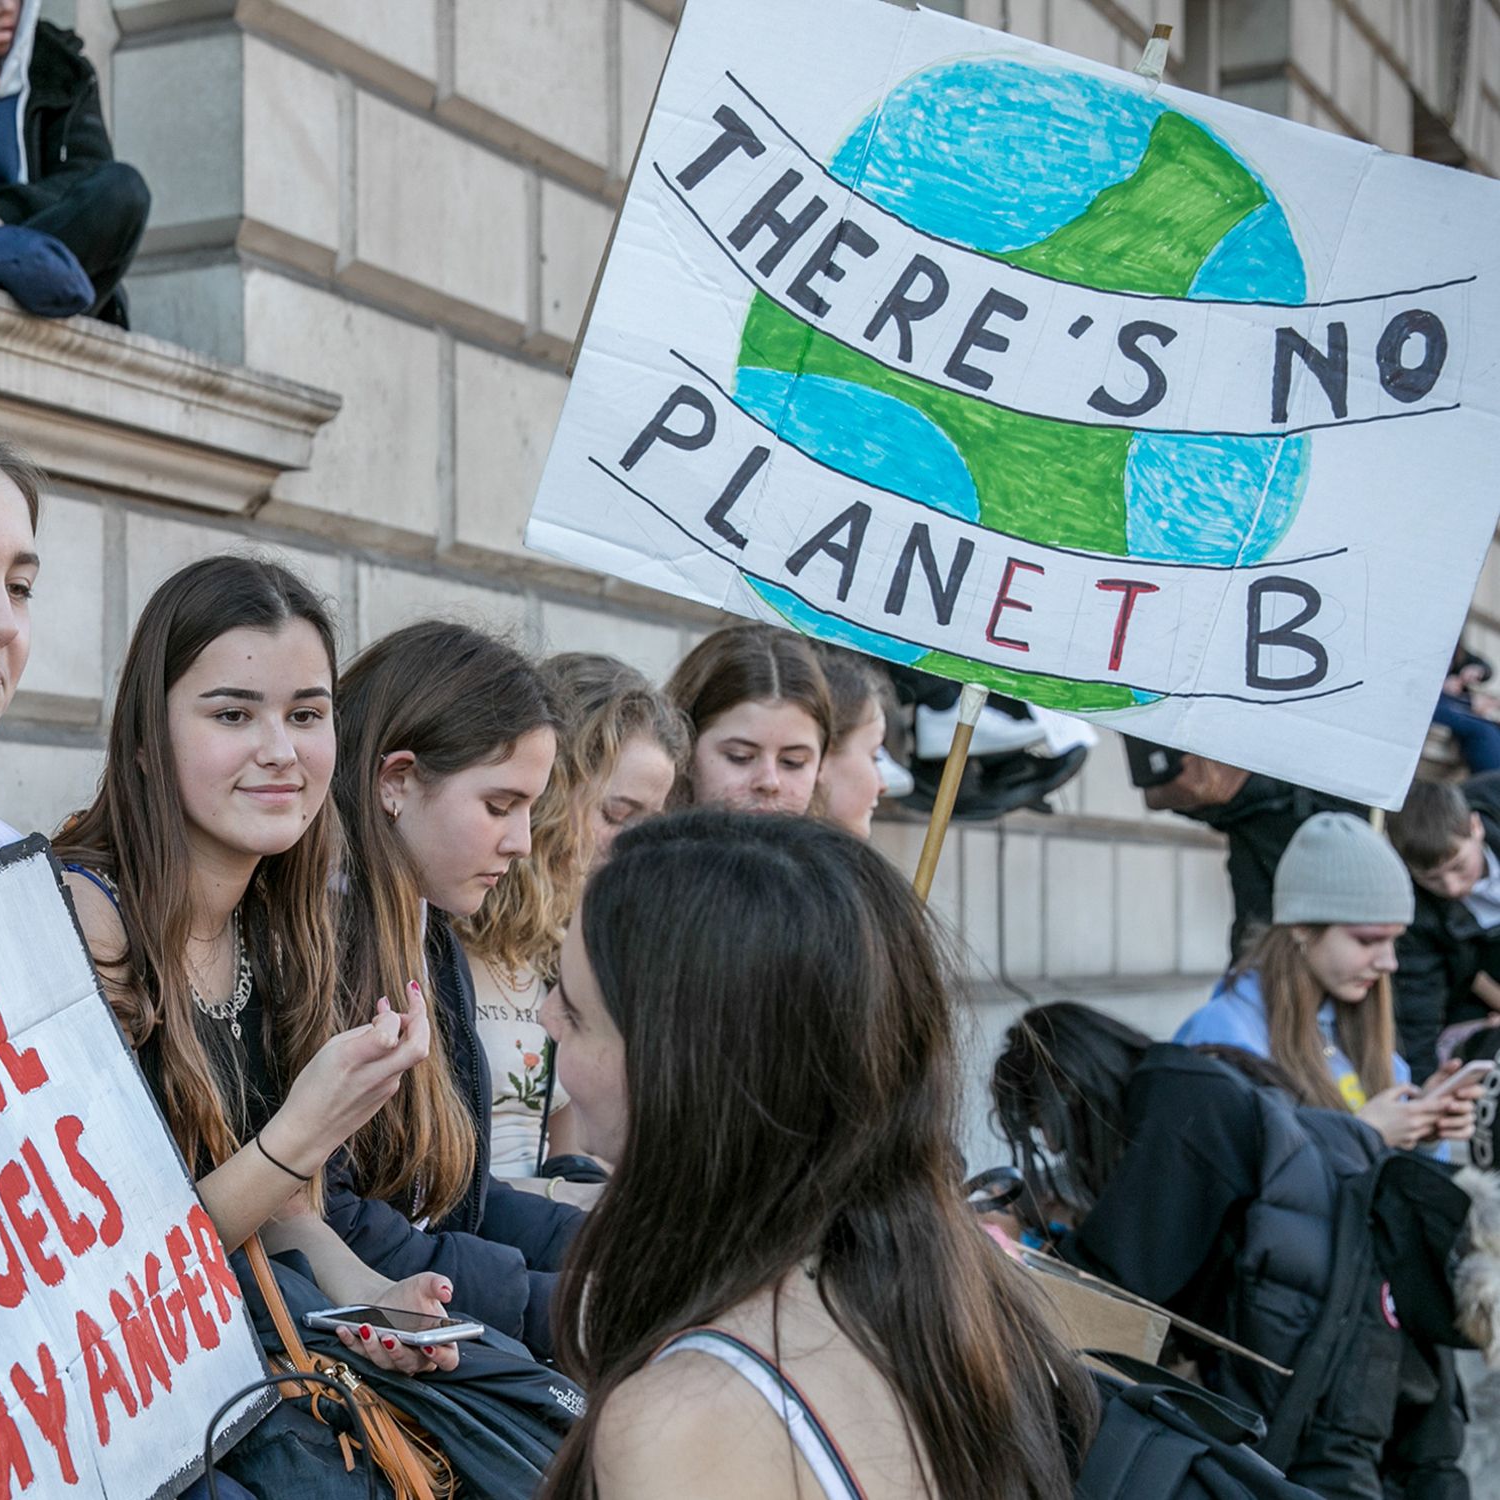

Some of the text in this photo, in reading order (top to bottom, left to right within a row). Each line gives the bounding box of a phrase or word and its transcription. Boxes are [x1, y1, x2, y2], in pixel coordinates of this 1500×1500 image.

[676, 104, 1448, 424] THERE'S NO
[618, 384, 1328, 691] PLANET B
[75, 1203, 243, 1448] ANGER
